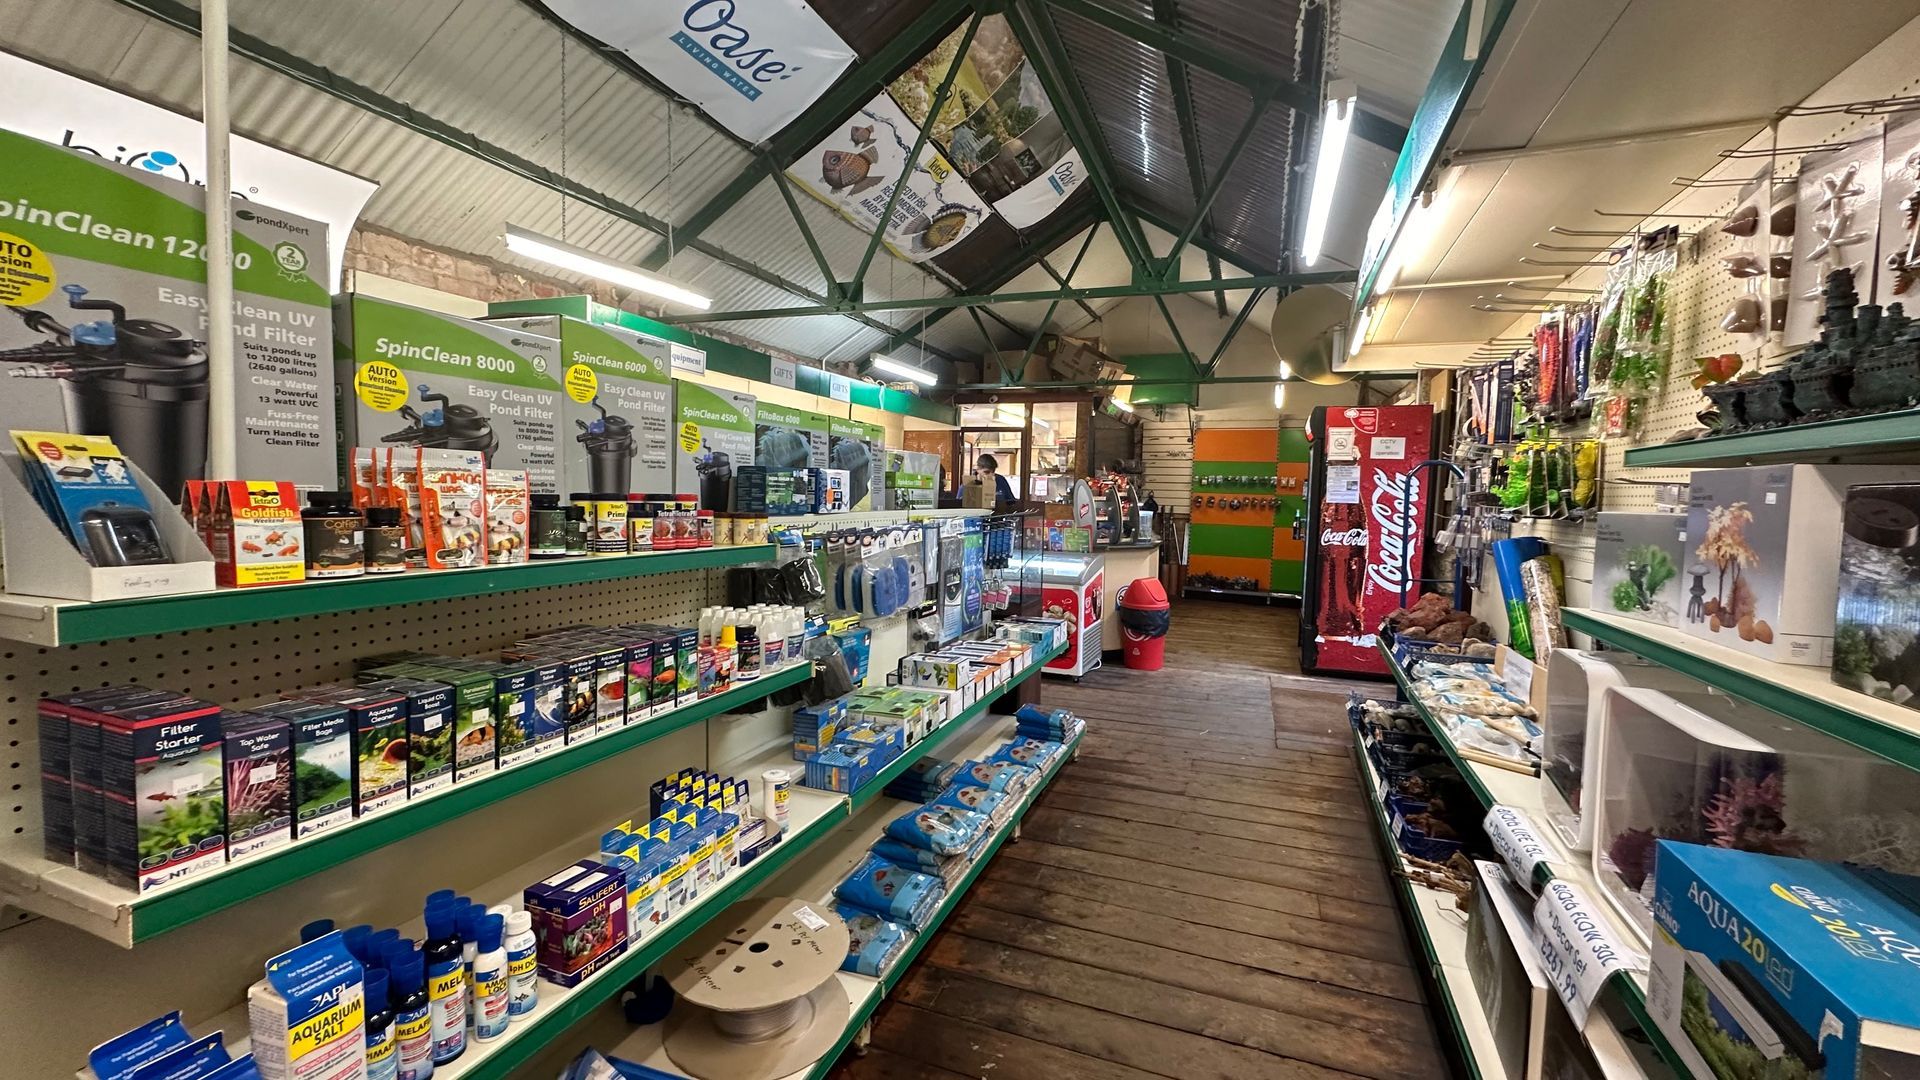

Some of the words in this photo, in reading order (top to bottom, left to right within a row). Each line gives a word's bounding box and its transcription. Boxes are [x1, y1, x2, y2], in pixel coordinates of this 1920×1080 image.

[678, 37, 718, 70] LIVING
[723, 70, 755, 98] WATER
[289, 311, 316, 328] UV
[264, 327, 316, 347] Filter
[243, 341, 269, 352] Suits
[271, 345, 302, 358] ponds
[304, 351, 317, 360] up
[375, 337, 472, 368] SpinClean
[476, 355, 515, 374] 8000
[246, 352, 258, 360] to
[261, 354, 290, 365] 12000
[292, 357, 317, 368] litres
[573, 351, 623, 369] SpinClean
[624, 361, 646, 374] 6000
[672, 352, 702, 367] quipment
[248, 361, 276, 373] (2640
[279, 366, 317, 378] gallons)
[367, 364, 398, 378] AUTO
[573, 368, 591, 377] AUTO
[773, 367, 793, 381] GIFTS
[251, 376, 281, 387] Clear
[284, 379, 318, 391] Water
[368, 373, 397, 386] Version
[275, 388, 318, 399] Powerful
[468, 385, 497, 400] Easy
[501, 389, 534, 403] Clean
[538, 393, 553, 405] UV
[604, 383, 625, 397] Easy
[627, 387, 651, 399] Clean
[653, 391, 665, 400] UV
[832, 382, 848, 394] GIFTS
[258, 396, 269, 404] 13
[268, 398, 296, 407] watt
[299, 400, 319, 408] UVC
[618, 399, 641, 410] Pond
[643, 402, 666, 412] Filter
[267, 410, 320, 422] Fuss-Free
[489, 403, 521, 417] Pond
[524, 407, 553, 420] Filter
[683, 406, 720, 420] SpinClean
[721, 413, 738, 423] 4500
[757, 410, 784, 421] FiltoBox
[245, 417, 320, 430] Maintenance
[247, 428, 270, 436] Turn
[273, 430, 306, 439] Handle
[265, 437, 293, 446] Clean
[296, 439, 320, 448] Filter
[241, 507, 294, 518] Goldfish
[1320, 528, 1368, 546] Coca-Cola
[1366, 579, 1375, 596] Enjoy
[417, 695, 435, 705] Liquid
[424, 701, 440, 710] Boost
[368, 705, 398, 717] Aquarium
[371, 713, 395, 724] Cleaner
[161, 723, 198, 737] Filter
[302, 722, 322, 733] Filter
[322, 717, 344, 729] Media
[315, 728, 333, 737] Bags
[155, 734, 203, 751] Starter
[239, 738, 254, 747] Tap
[255, 732, 280, 743] Water
[251, 742, 270, 752] Safe
[162, 747, 198, 759] Aquarium
[1511, 829, 1534, 842] LIFE
[1492, 824, 1511, 857] Decor
[1511, 848, 1521, 870] Set
[579, 881, 619, 909] SALIFERT
[593, 900, 606, 917] pH
[1552, 915, 1574, 956] Decor
[1572, 949, 1588, 977] Set
[1570, 912, 1604, 942] FLOW
[1592, 944, 1618, 967] 30L
[581, 962, 595, 980] pH
[319, 983, 347, 1007] API
[412, 1006, 427, 1020] API
[292, 999, 362, 1045] AQUARIUM
[314, 1020, 345, 1046] SALT
